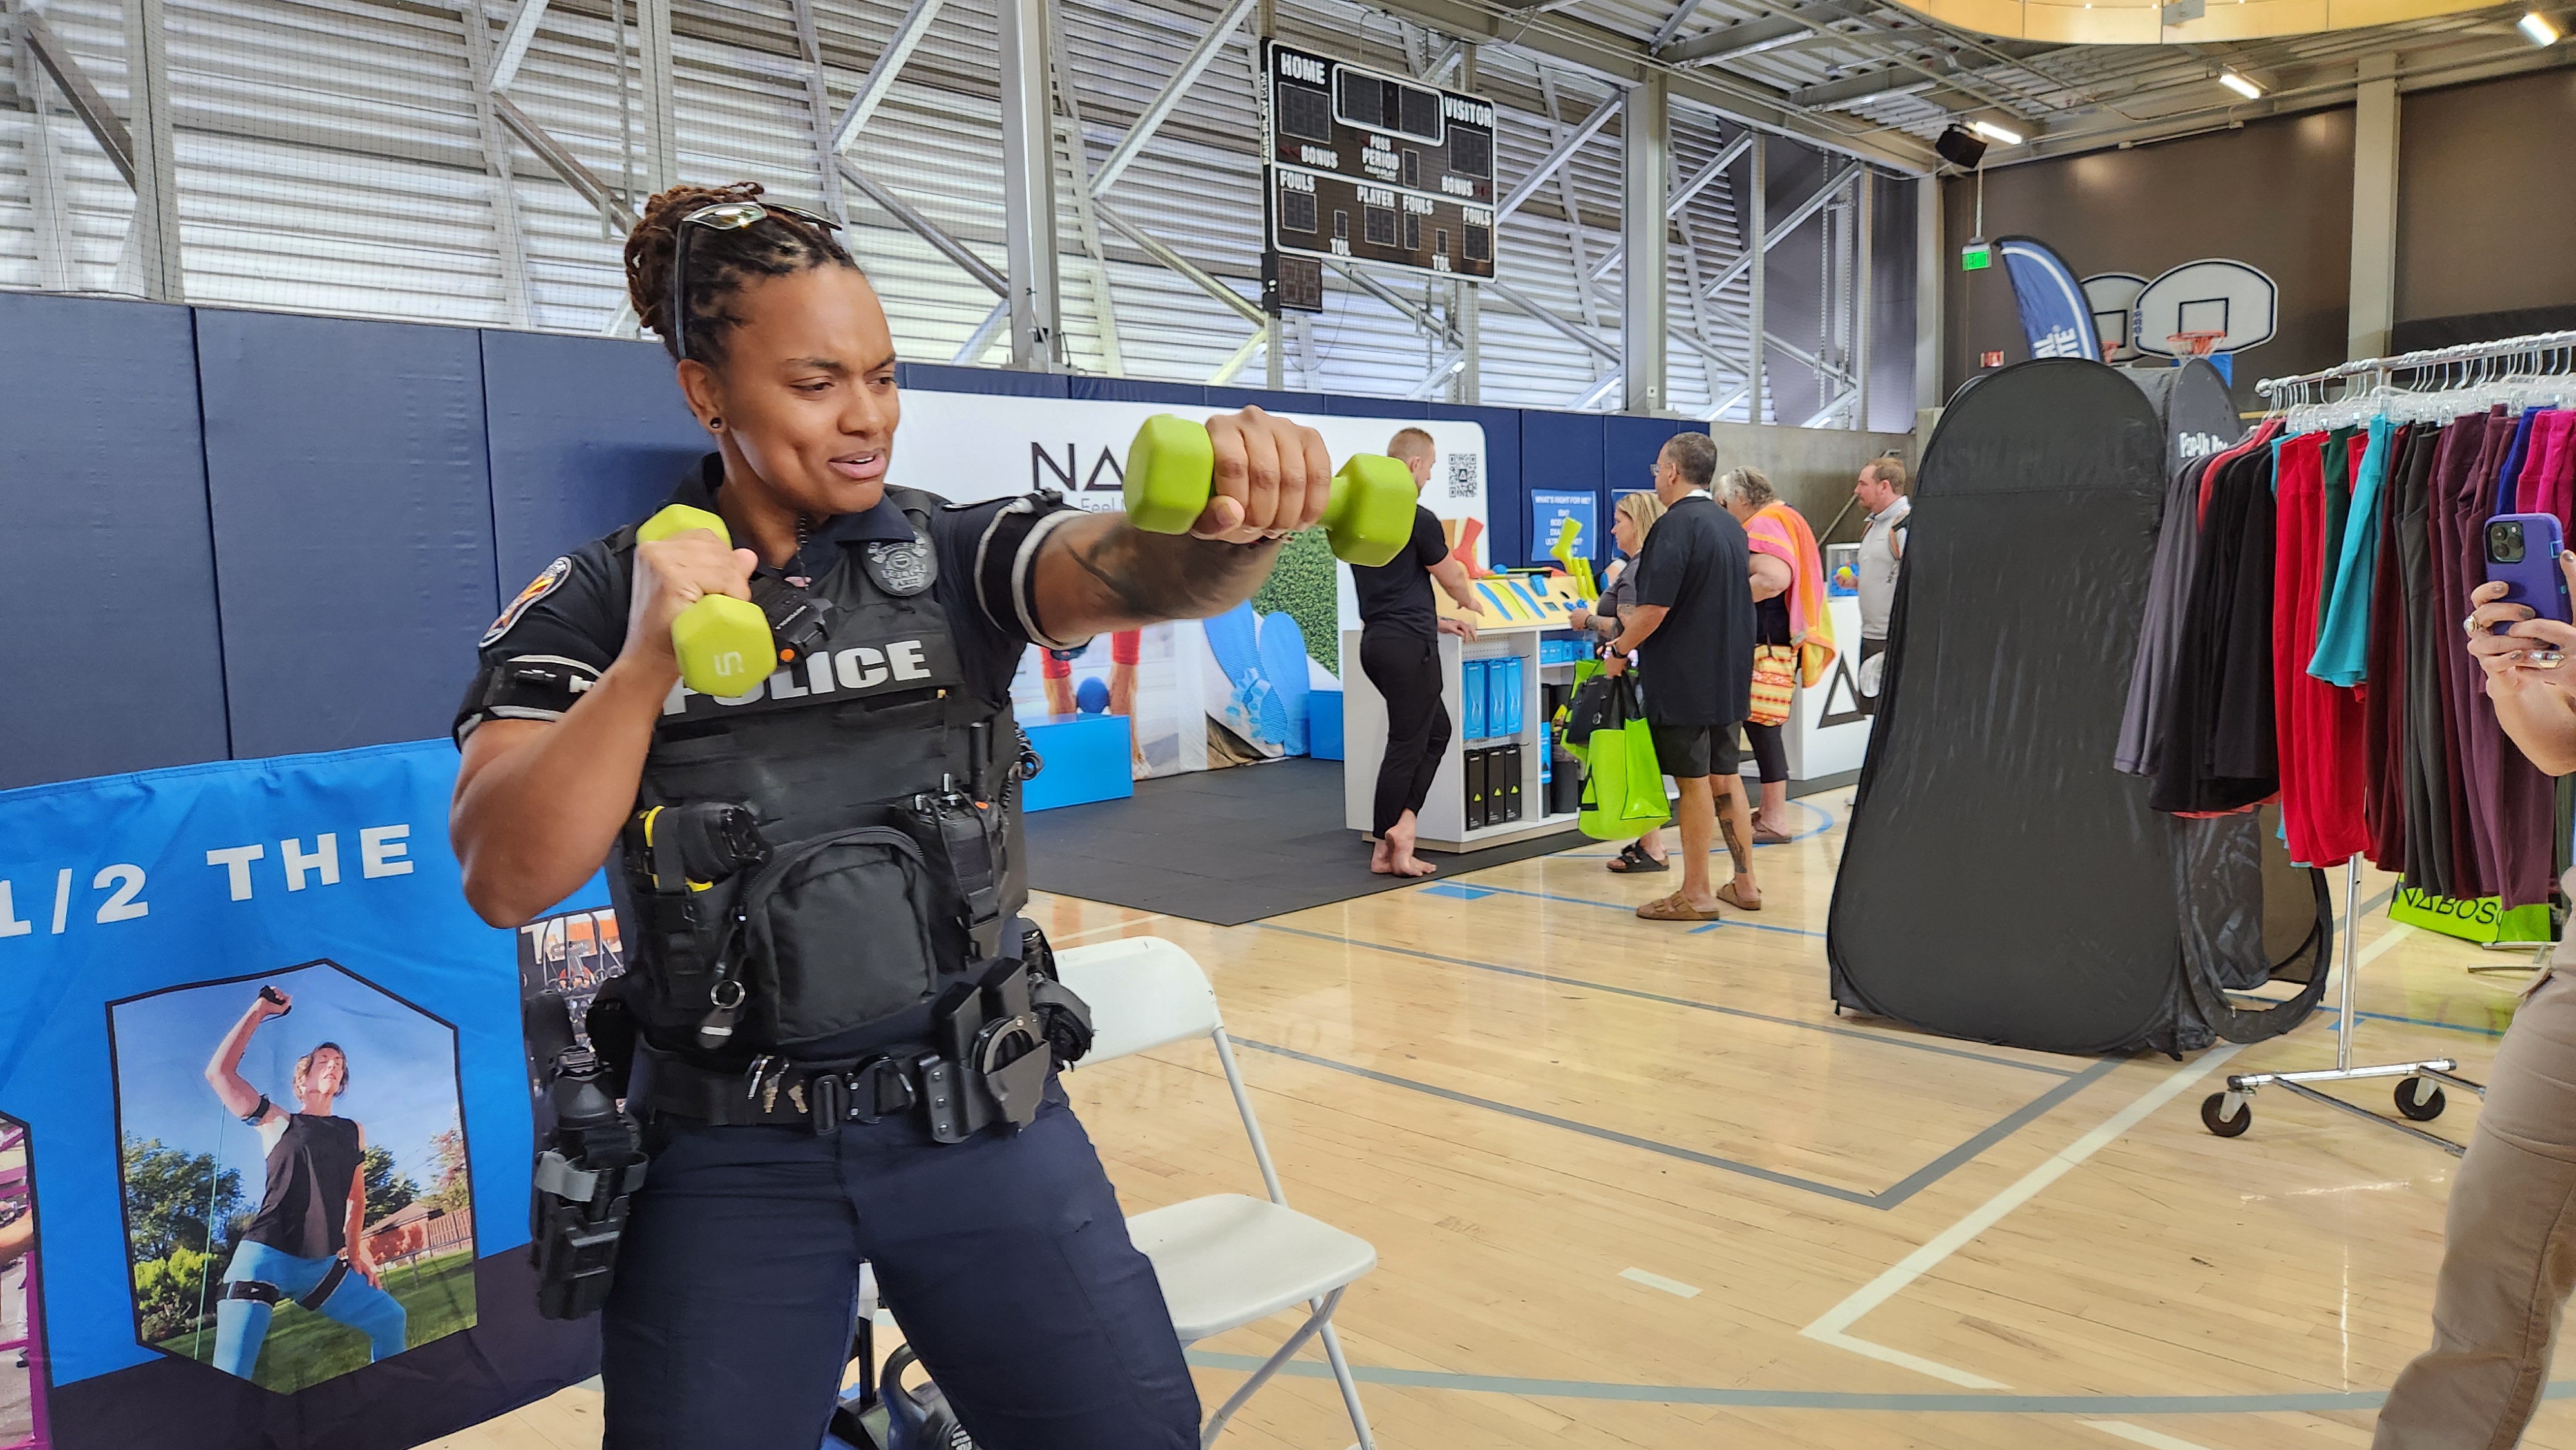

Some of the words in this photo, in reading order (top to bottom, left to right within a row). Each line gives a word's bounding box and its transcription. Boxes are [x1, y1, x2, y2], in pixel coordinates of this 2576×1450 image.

[1280, 52, 1326, 85] HOME
[1444, 96, 1492, 127] VISITOR
[1369, 135, 1392, 152] POSS
[1300, 145, 1338, 169] BONUS
[1361, 147, 1399, 171] PERIOD
[1280, 170, 1316, 193] FOULS
[1441, 175, 1474, 197] BONUS
[1356, 185, 1396, 208] PLAYER
[1403, 194, 1434, 216] FOULS
[1462, 206, 1492, 227] FOULS
[1329, 237, 1352, 257] TOL
[1432, 254, 1452, 272] TOL
[714, 650, 744, 677] 5
[206, 824, 414, 901] THE
